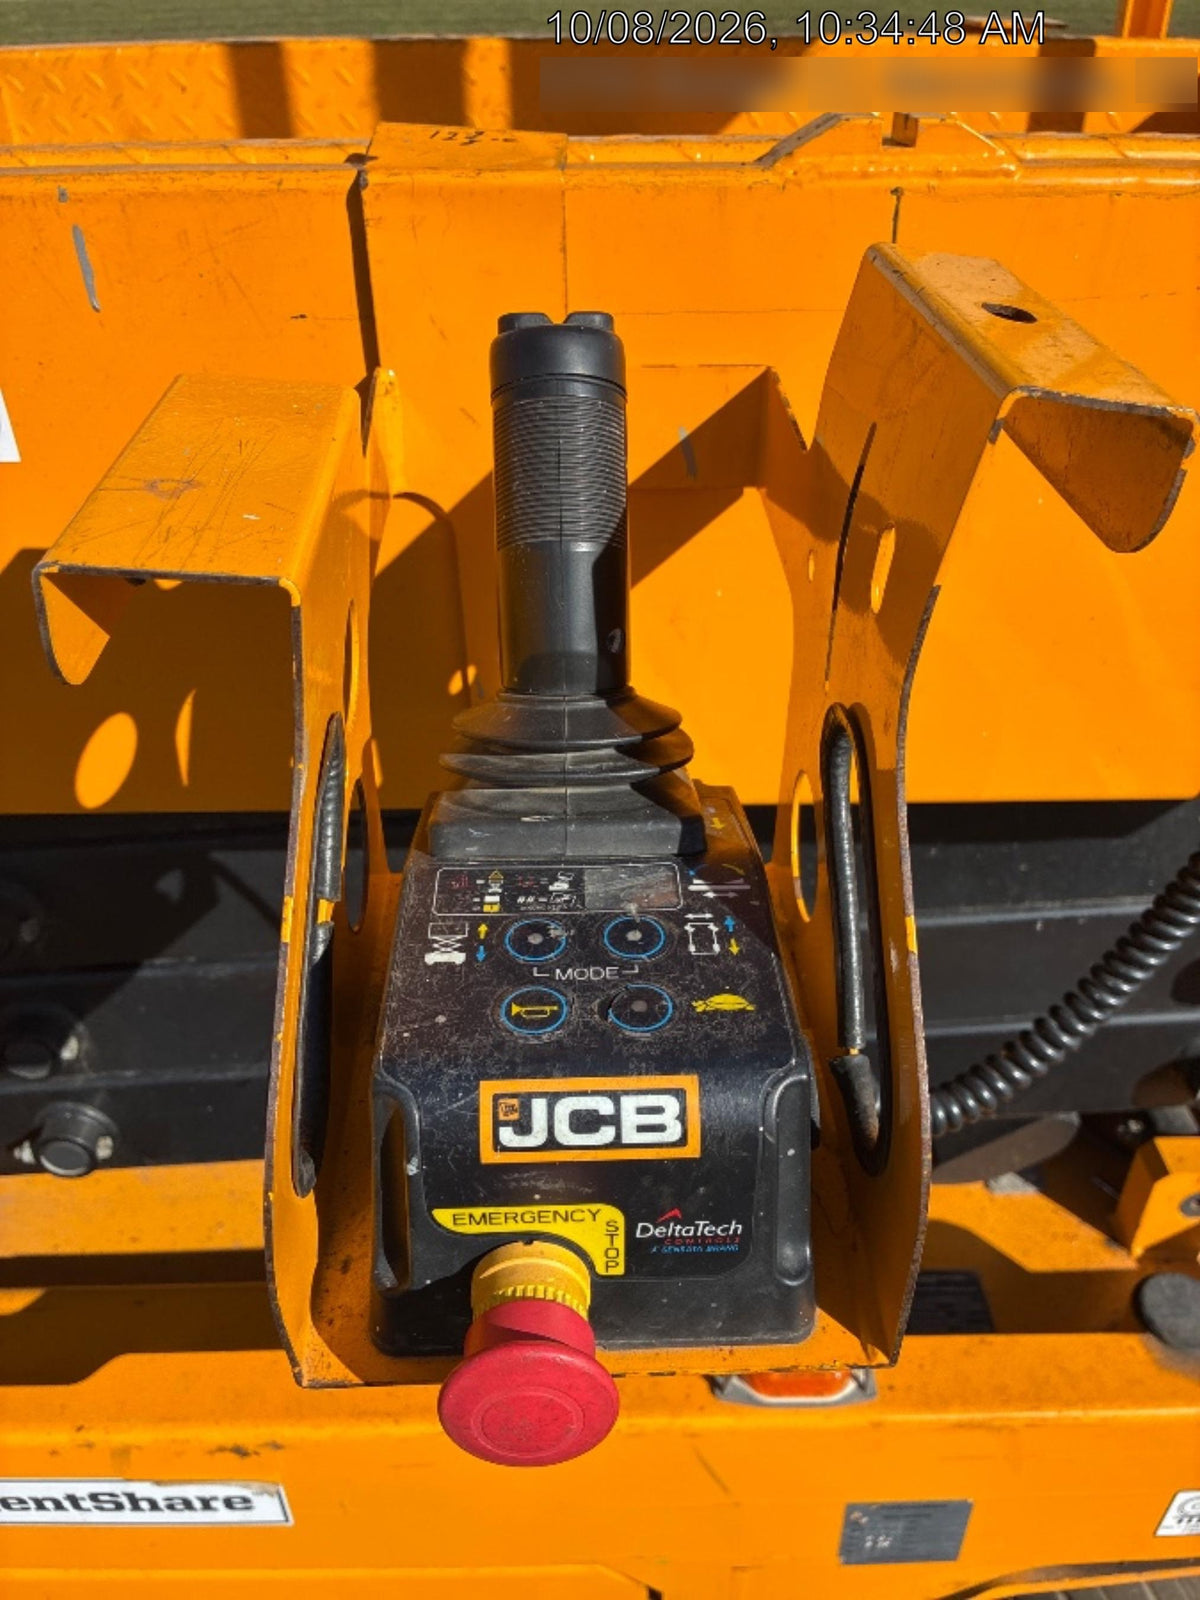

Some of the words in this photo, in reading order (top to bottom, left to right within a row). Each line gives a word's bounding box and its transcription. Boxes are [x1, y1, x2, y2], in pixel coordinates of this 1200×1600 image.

[555, 966, 619, 980] MODE
[498, 1094, 682, 1147] JCB
[453, 1209, 600, 1226] EMERGENCY
[635, 1220, 742, 1238] DeltaTech
[604, 1219, 620, 1273] STOP
[0, 1492, 255, 1512] entShare
